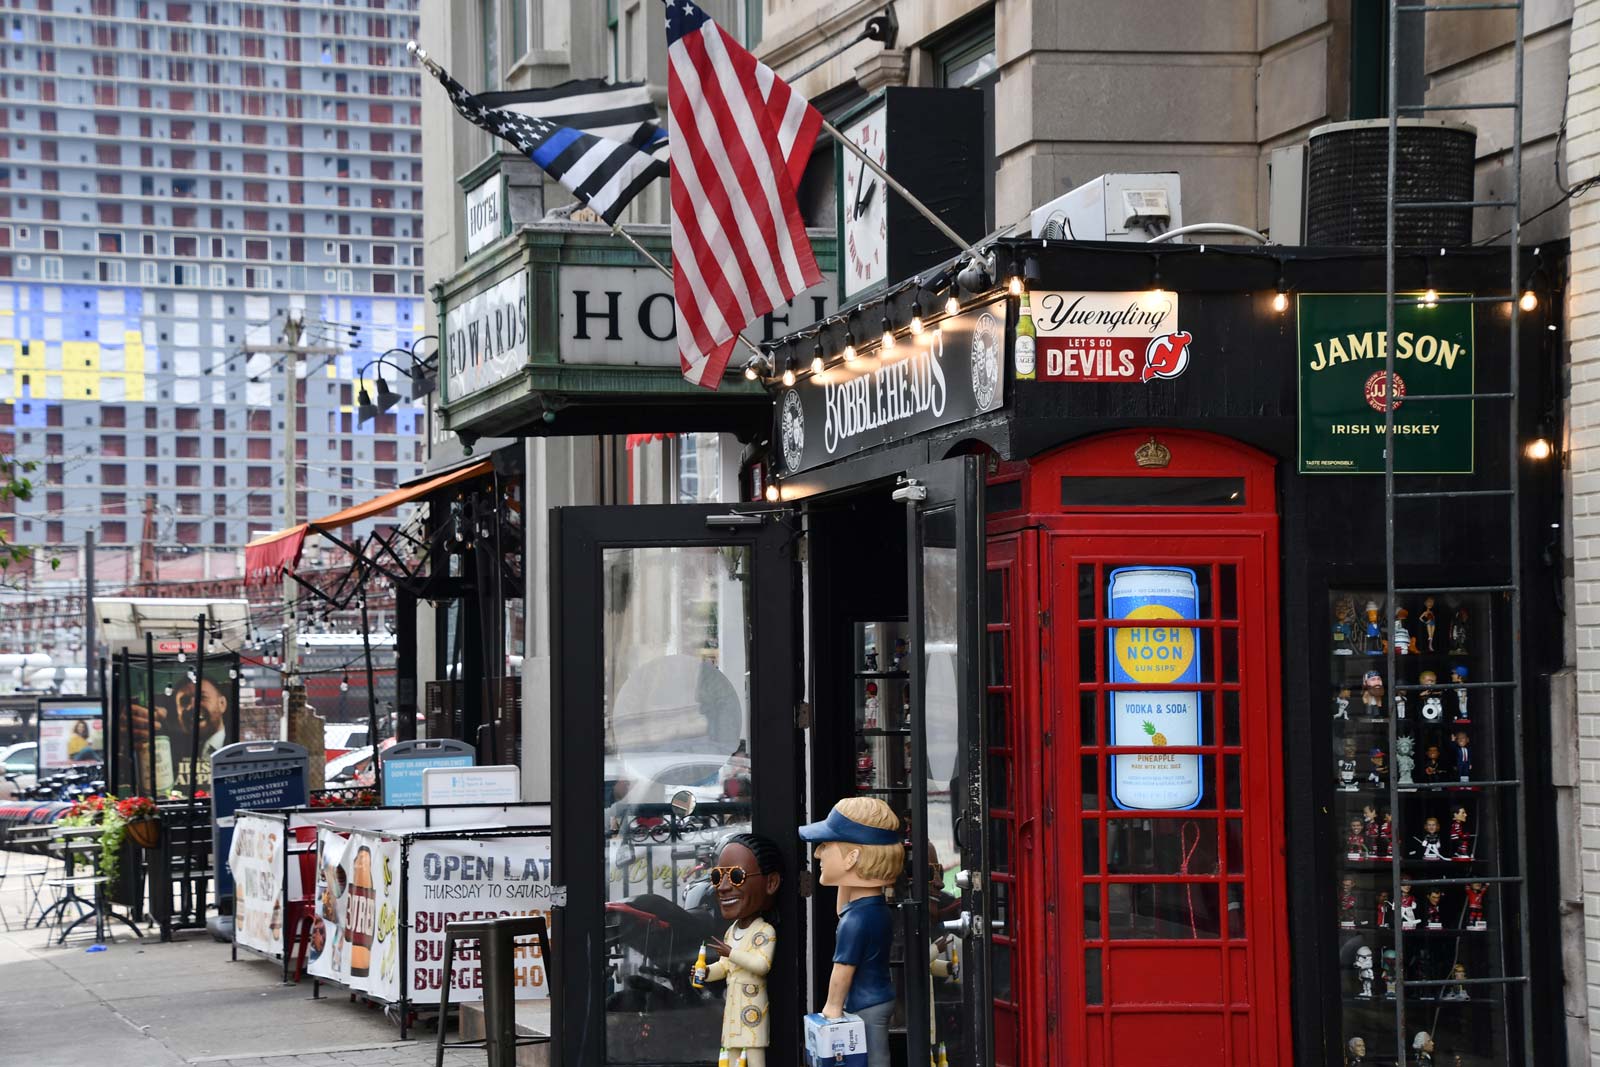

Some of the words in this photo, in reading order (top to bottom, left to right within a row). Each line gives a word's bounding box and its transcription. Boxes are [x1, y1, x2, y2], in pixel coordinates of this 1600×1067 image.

[470, 191, 499, 237] HOTEL
[572, 290, 829, 342] HOE
[1037, 293, 1173, 334] Yuengling
[449, 295, 527, 378] EDWARDS
[1069, 338, 1096, 347] LET'S
[1099, 339, 1112, 347] GO
[1310, 331, 1461, 371] JAMESON
[1047, 349, 1135, 377] DEVILS
[824, 328, 947, 454] BOBBLEHEADS
[1331, 424, 1370, 435] IRISH
[1131, 628, 1180, 643] HIGH
[1127, 646, 1183, 660] NOON
[1125, 703, 1153, 714] VODKA
[1155, 703, 1164, 714] &
[1166, 703, 1188, 714] SODA
[1137, 754, 1175, 762] PINEAPPLE
[235, 792, 262, 801] SECOND
[262, 789, 284, 798] FLOOR
[238, 784, 265, 794] HUDSON
[265, 781, 289, 790] STREET
[423, 852, 495, 882] OPEN
[424, 884, 485, 900] THURSDAY
[488, 883, 502, 899] TO
